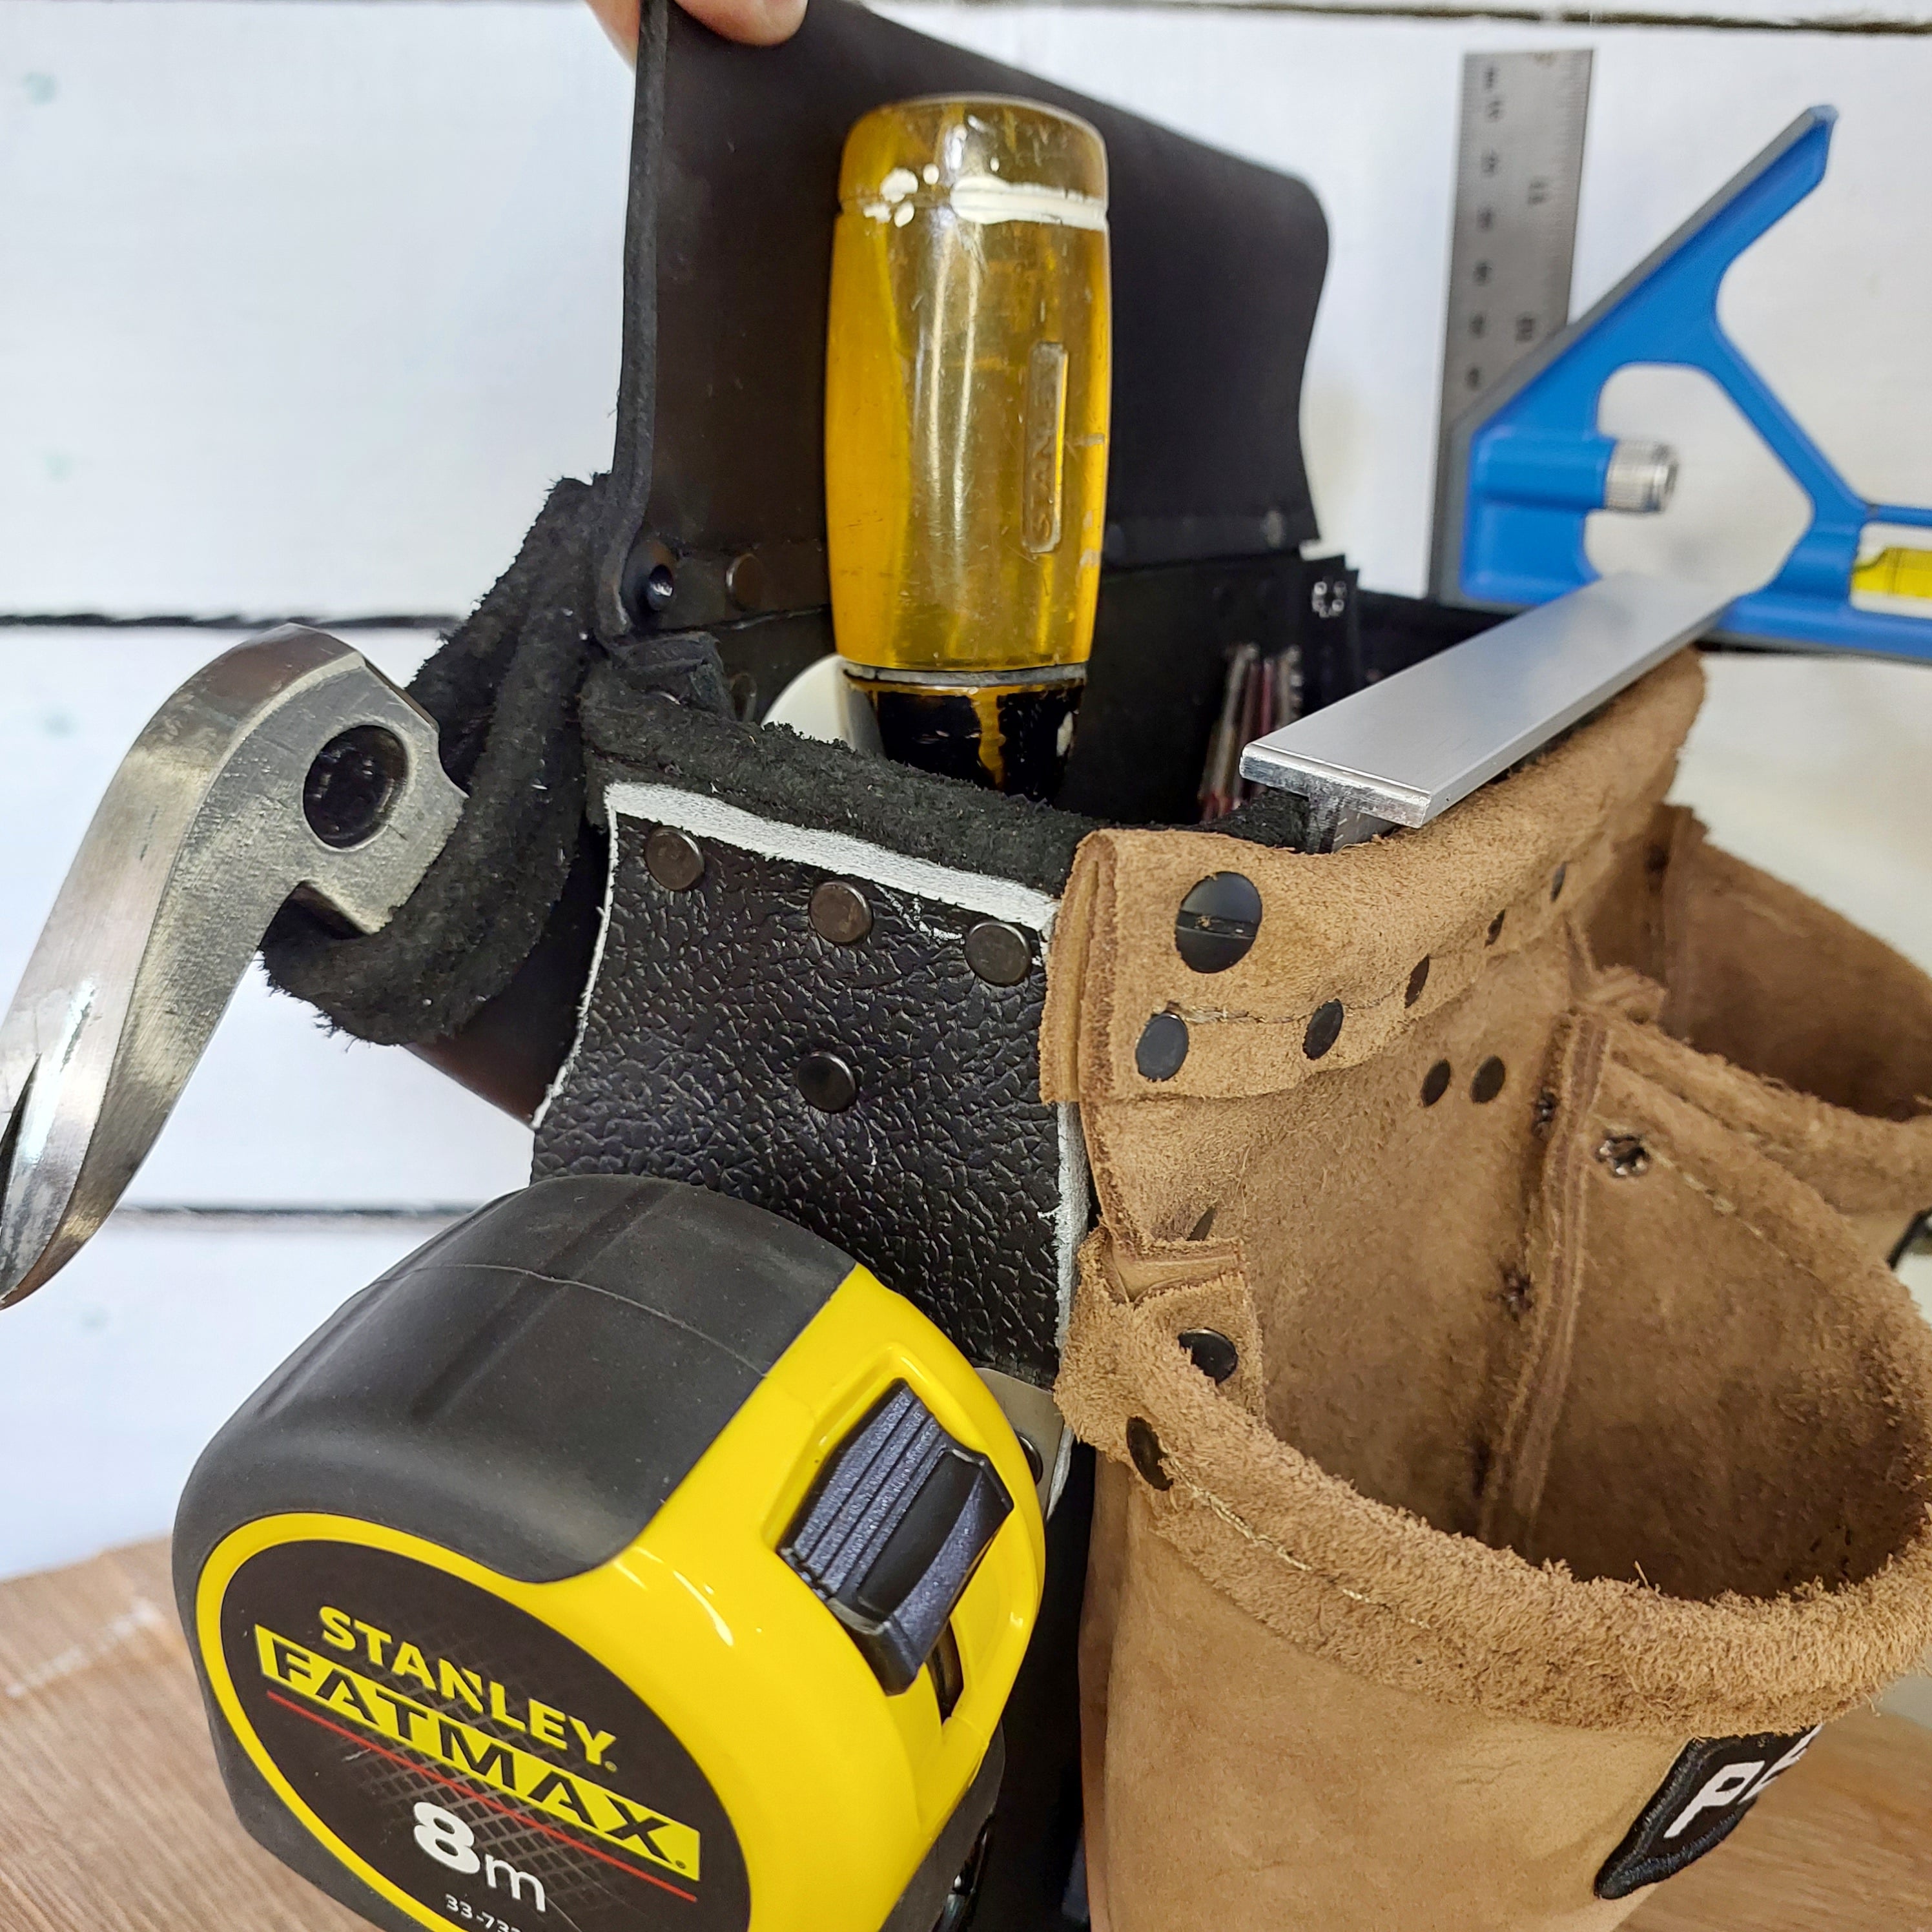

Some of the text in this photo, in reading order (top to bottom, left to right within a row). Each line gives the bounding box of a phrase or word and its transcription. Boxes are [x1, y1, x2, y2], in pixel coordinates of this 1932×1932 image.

[272, 1636, 673, 1864] FATMAX
[319, 1605, 617, 1766] STANLEY
[413, 1802, 546, 1912] 8m
